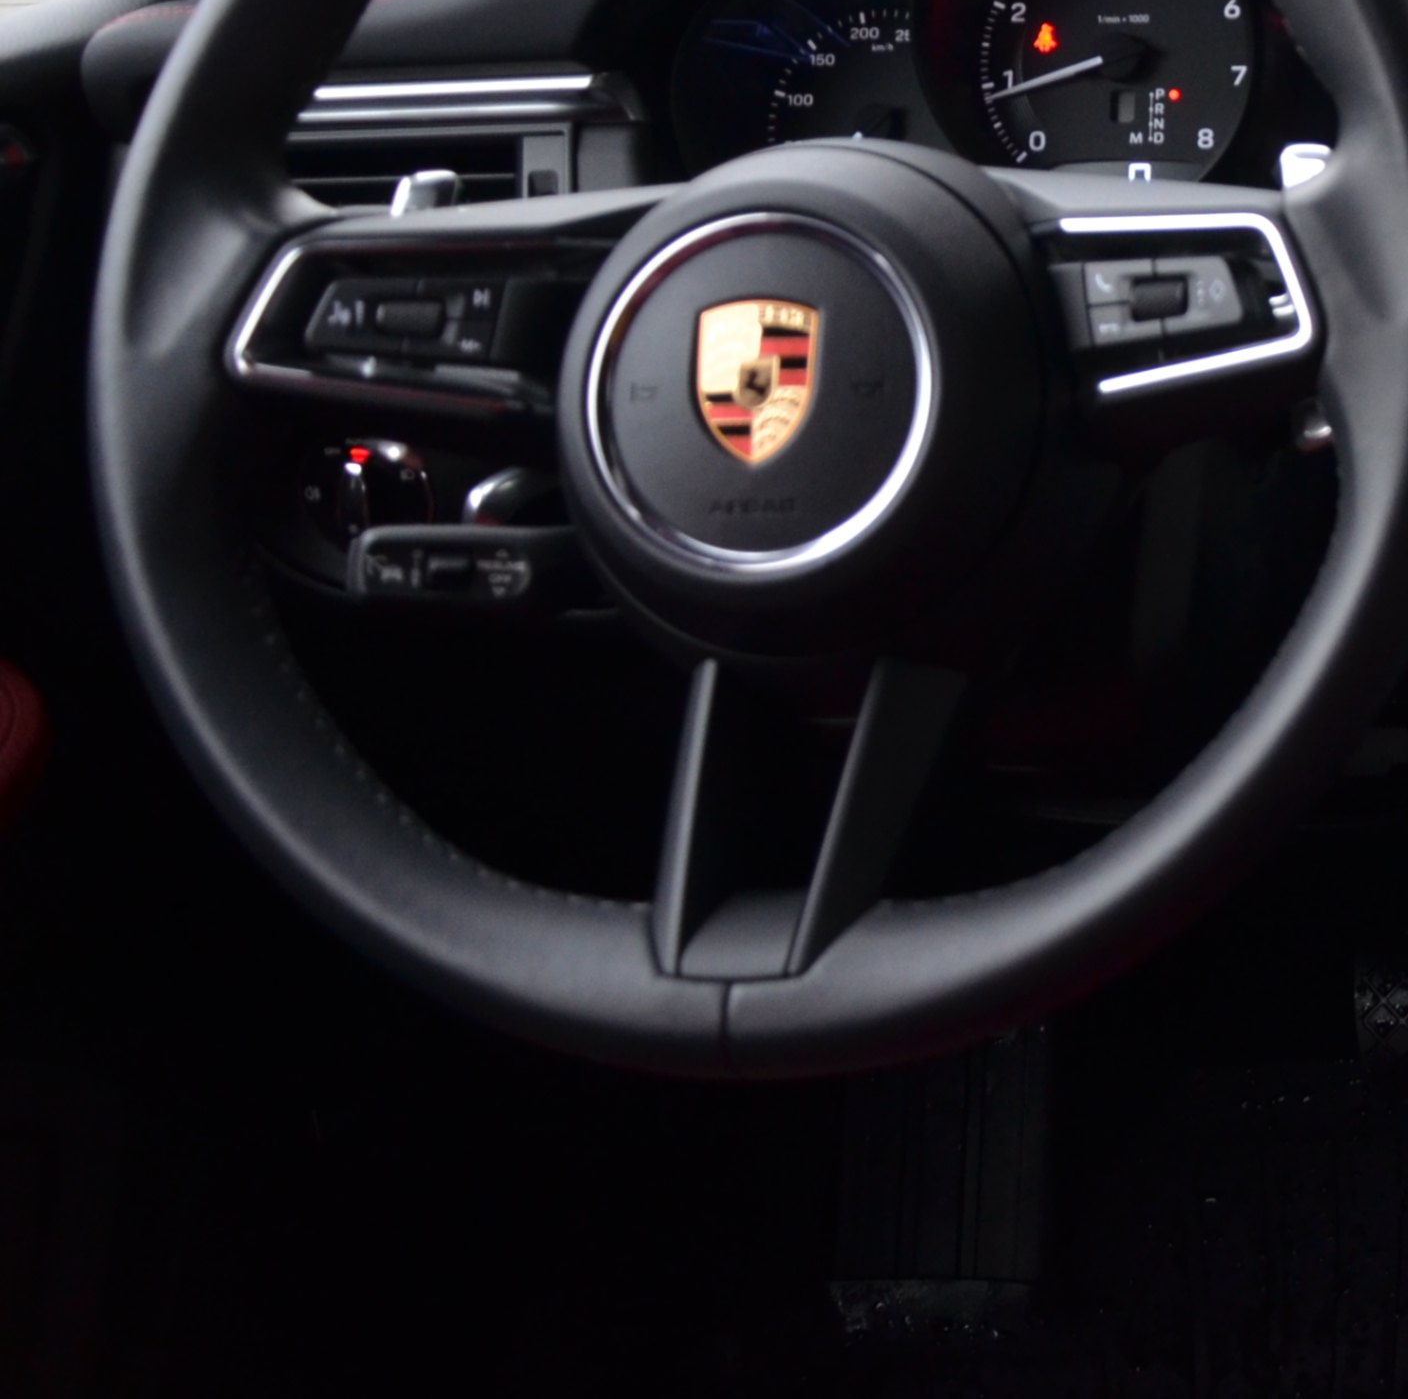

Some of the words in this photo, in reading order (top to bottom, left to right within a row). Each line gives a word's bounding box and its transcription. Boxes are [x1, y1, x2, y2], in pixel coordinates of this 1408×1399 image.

[1011, 3, 1026, 22] 2
[1224, 0, 1240, 19] 6
[850, 27, 880, 40] 200
[810, 54, 835, 66] 150
[1003, 70, 1014, 88] 1
[1232, 66, 1247, 85] 7
[788, 94, 814, 106] 100
[1155, 88, 1165, 100] P
[1155, 103, 1165, 115] R
[1154, 118, 1164, 130] N
[1029, 131, 1045, 151] 0
[1129, 133, 1143, 144] M
[1154, 133, 1164, 144] D
[1198, 129, 1213, 149] 8
